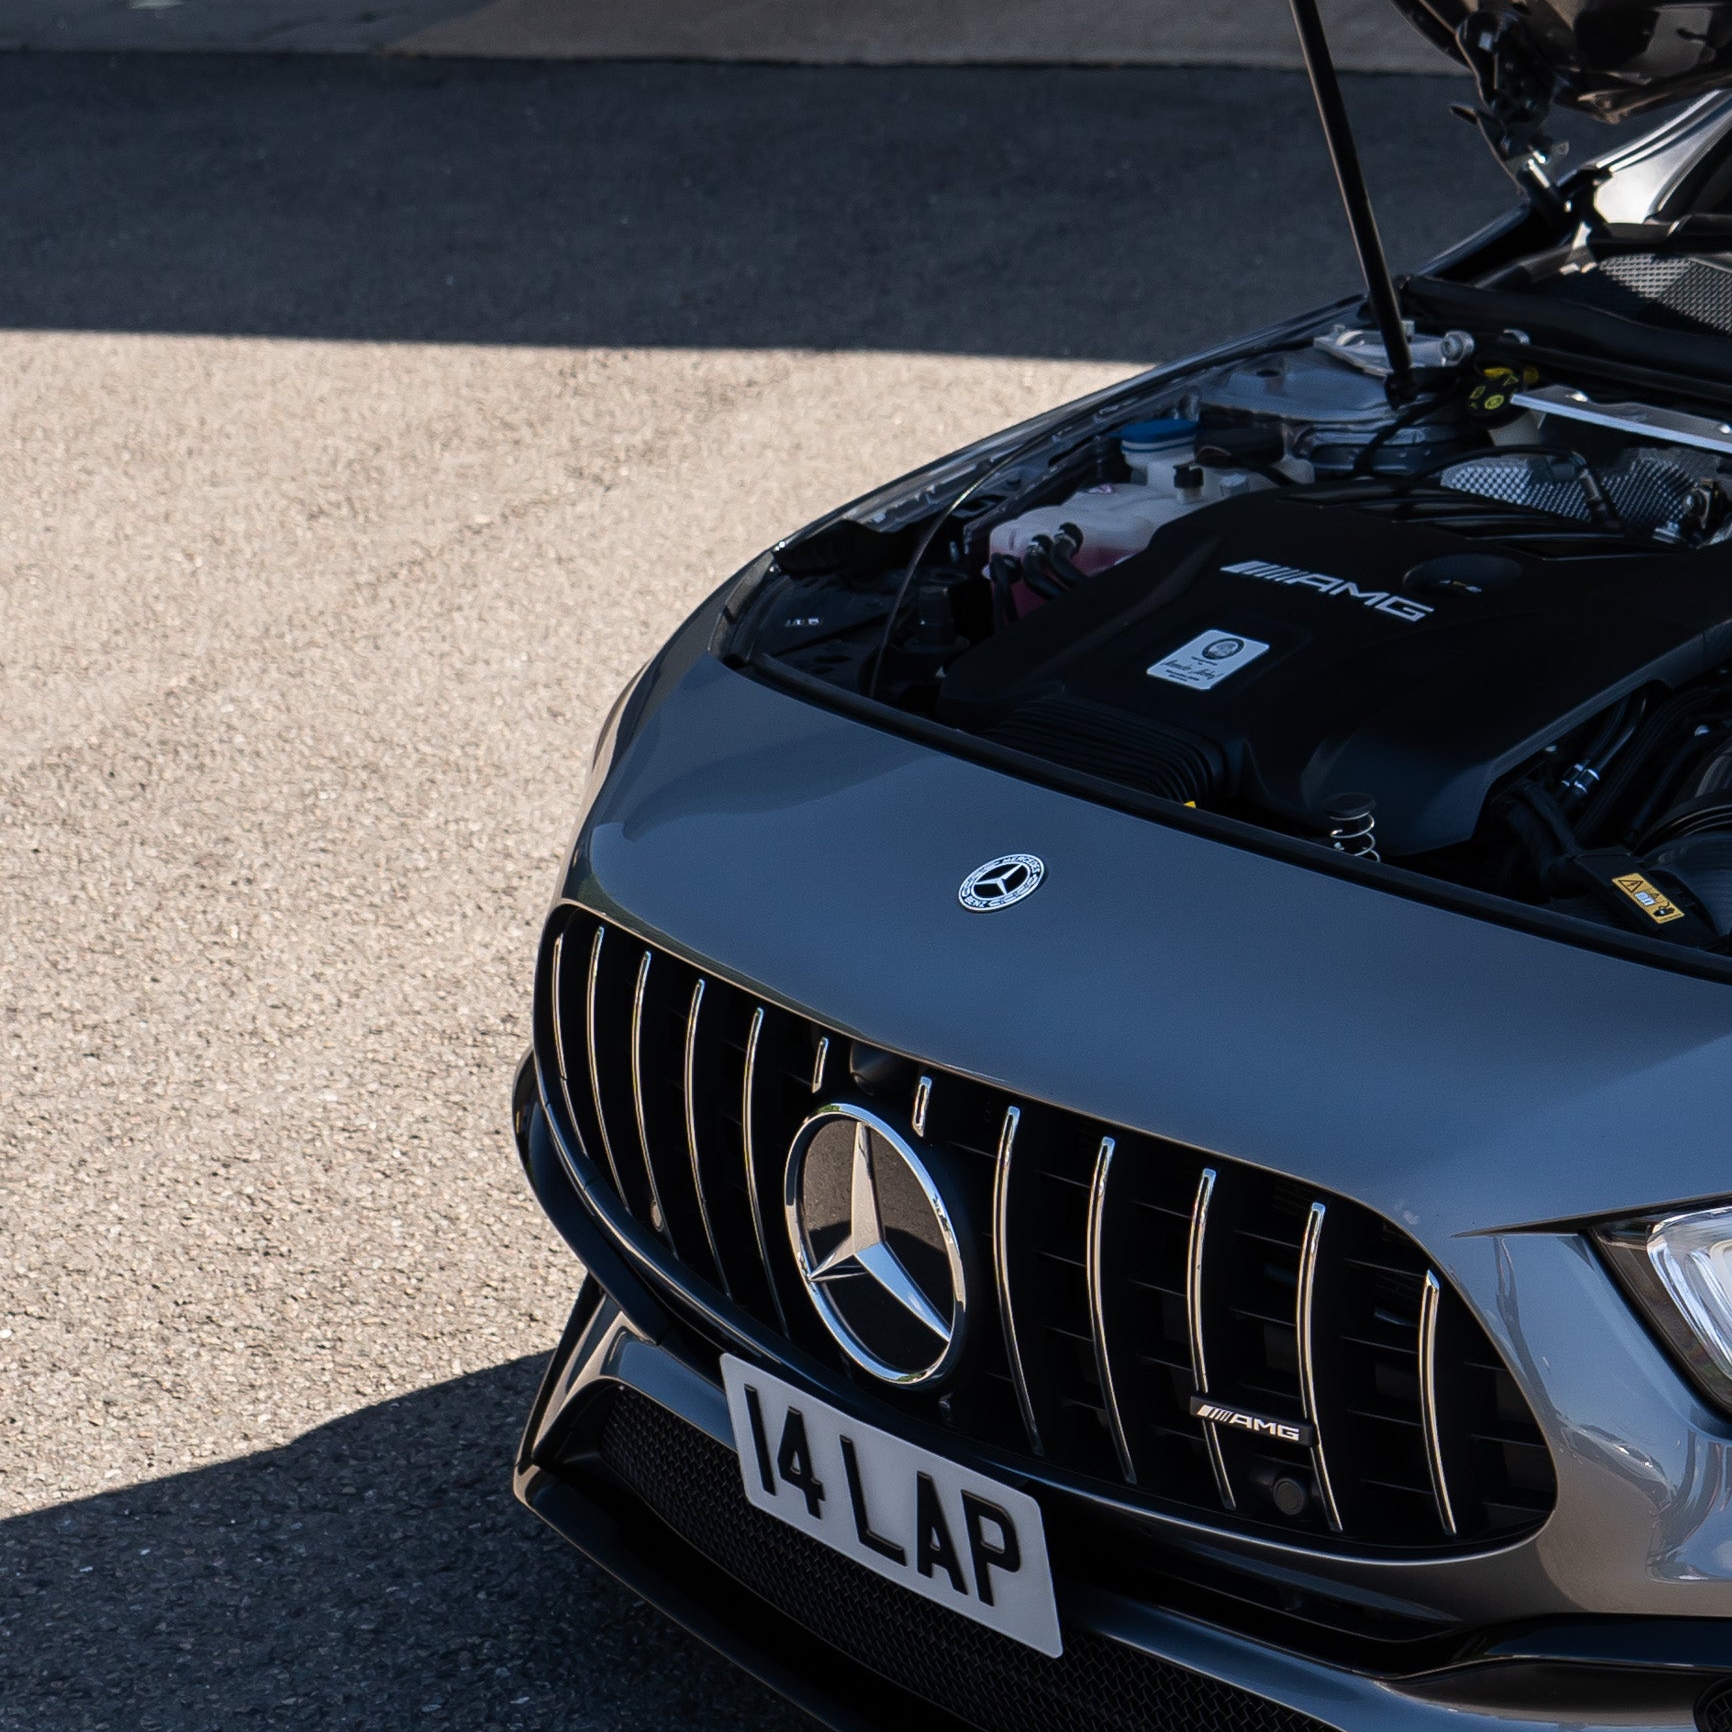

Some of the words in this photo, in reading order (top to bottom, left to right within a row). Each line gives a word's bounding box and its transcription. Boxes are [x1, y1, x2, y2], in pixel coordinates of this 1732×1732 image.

[1282, 572, 1436, 623] AMG
[1002, 855, 1041, 874] MERCEDES
[964, 895, 987, 909] BENZ
[1229, 1413, 1301, 1443] AMG
[743, 1382, 827, 1521] 14
[839, 1434, 1023, 1608] LAP
